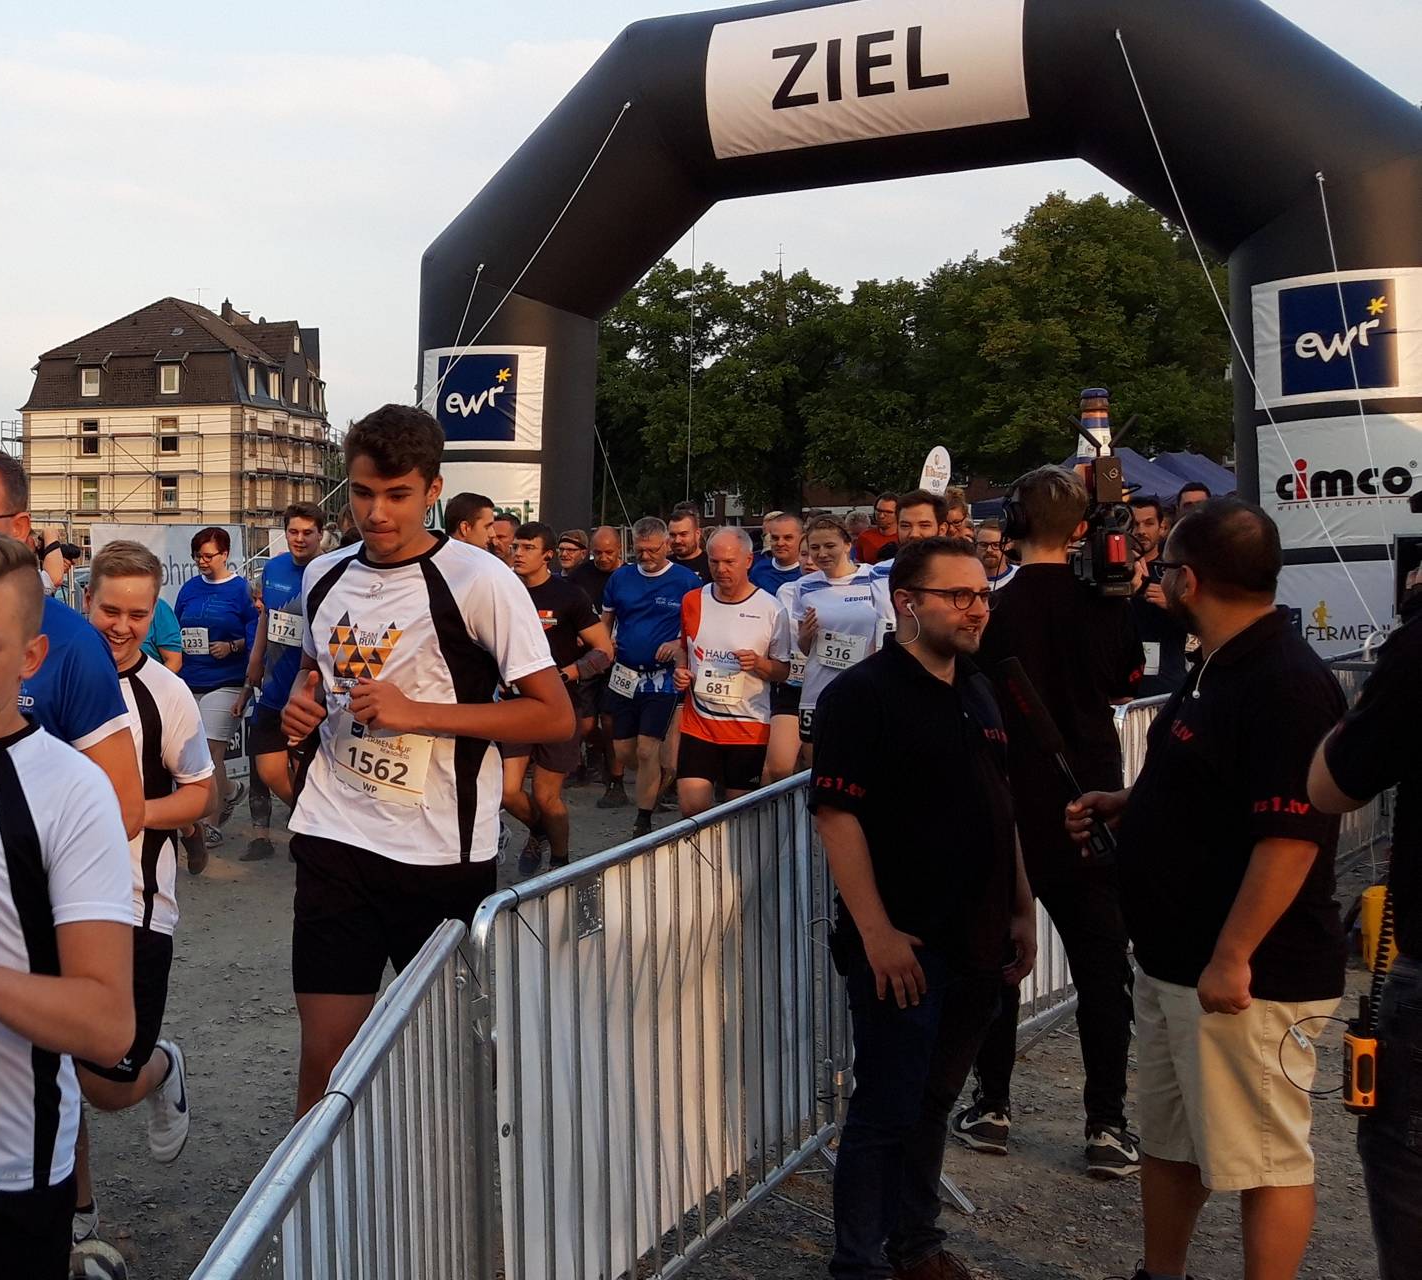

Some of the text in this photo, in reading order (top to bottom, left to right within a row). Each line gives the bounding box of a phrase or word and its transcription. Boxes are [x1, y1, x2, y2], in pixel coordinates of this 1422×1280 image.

[772, 26, 949, 110] ZIEL
[1295, 319, 1380, 362] ewr
[445, 385, 505, 418] ewr
[1276, 459, 1413, 500] cimco
[272, 624, 296, 637] 1174
[360, 630, 379, 640] TEAM
[182, 639, 203, 648] 1233
[358, 638, 378, 647] RUN
[705, 649, 740, 661] HAUC
[825, 646, 851, 660] 516
[791, 664, 805, 674] 97
[612, 674, 632, 690] 1268
[706, 682, 730, 695] 681
[348, 746, 409, 786] 1562
[362, 781, 378, 794] WP
